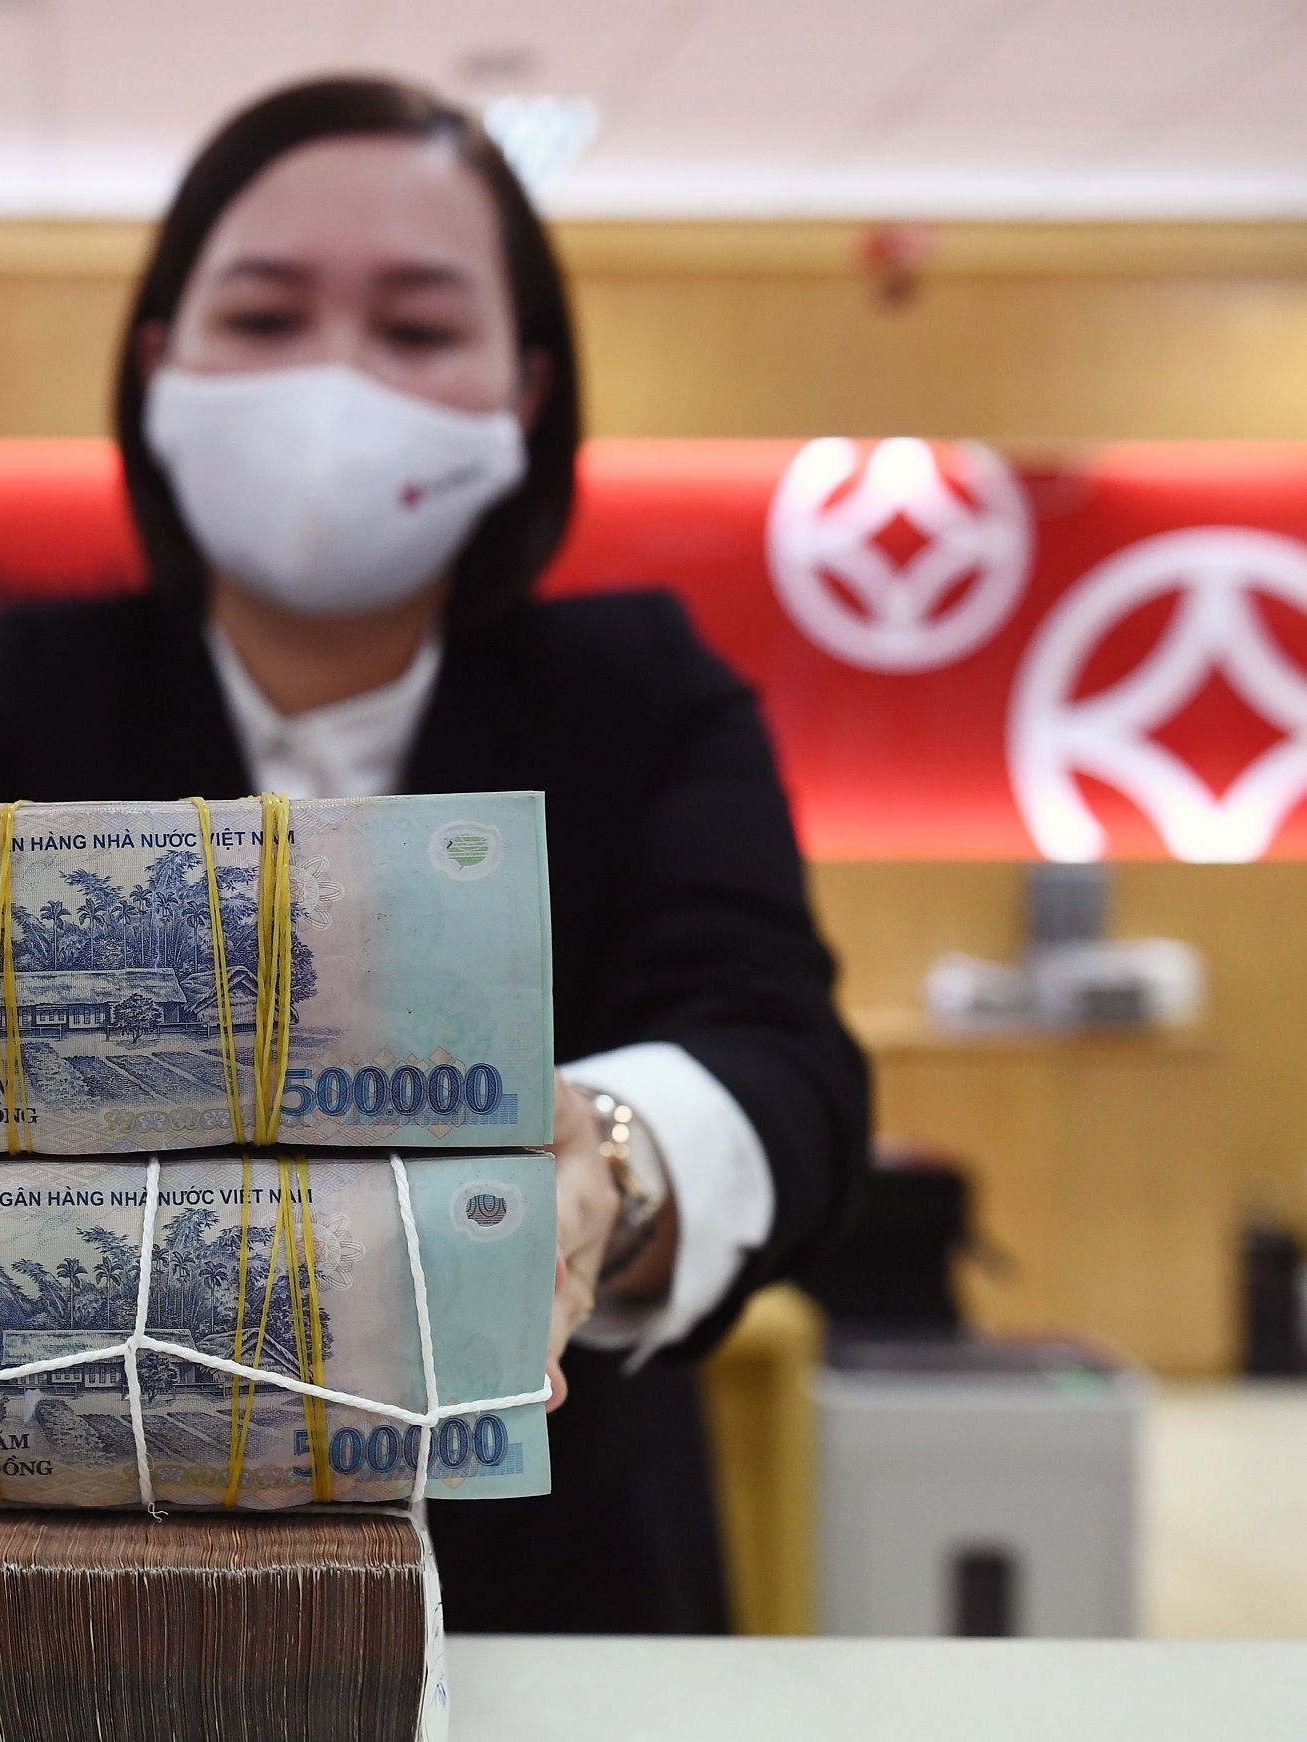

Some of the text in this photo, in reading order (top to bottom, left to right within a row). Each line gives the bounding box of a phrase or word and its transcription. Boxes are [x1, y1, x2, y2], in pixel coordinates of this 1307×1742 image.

[31, 831, 87, 851] HÀNG
[93, 828, 135, 849] NHÀ
[141, 829, 197, 848] NƯỚC
[251, 830, 295, 846] NM
[280, 1062, 503, 1117] 500.000
[47, 1186, 104, 1206] HÀNG
[110, 1186, 149, 1207] NHÀ
[158, 1186, 214, 1206] NƯỚC
